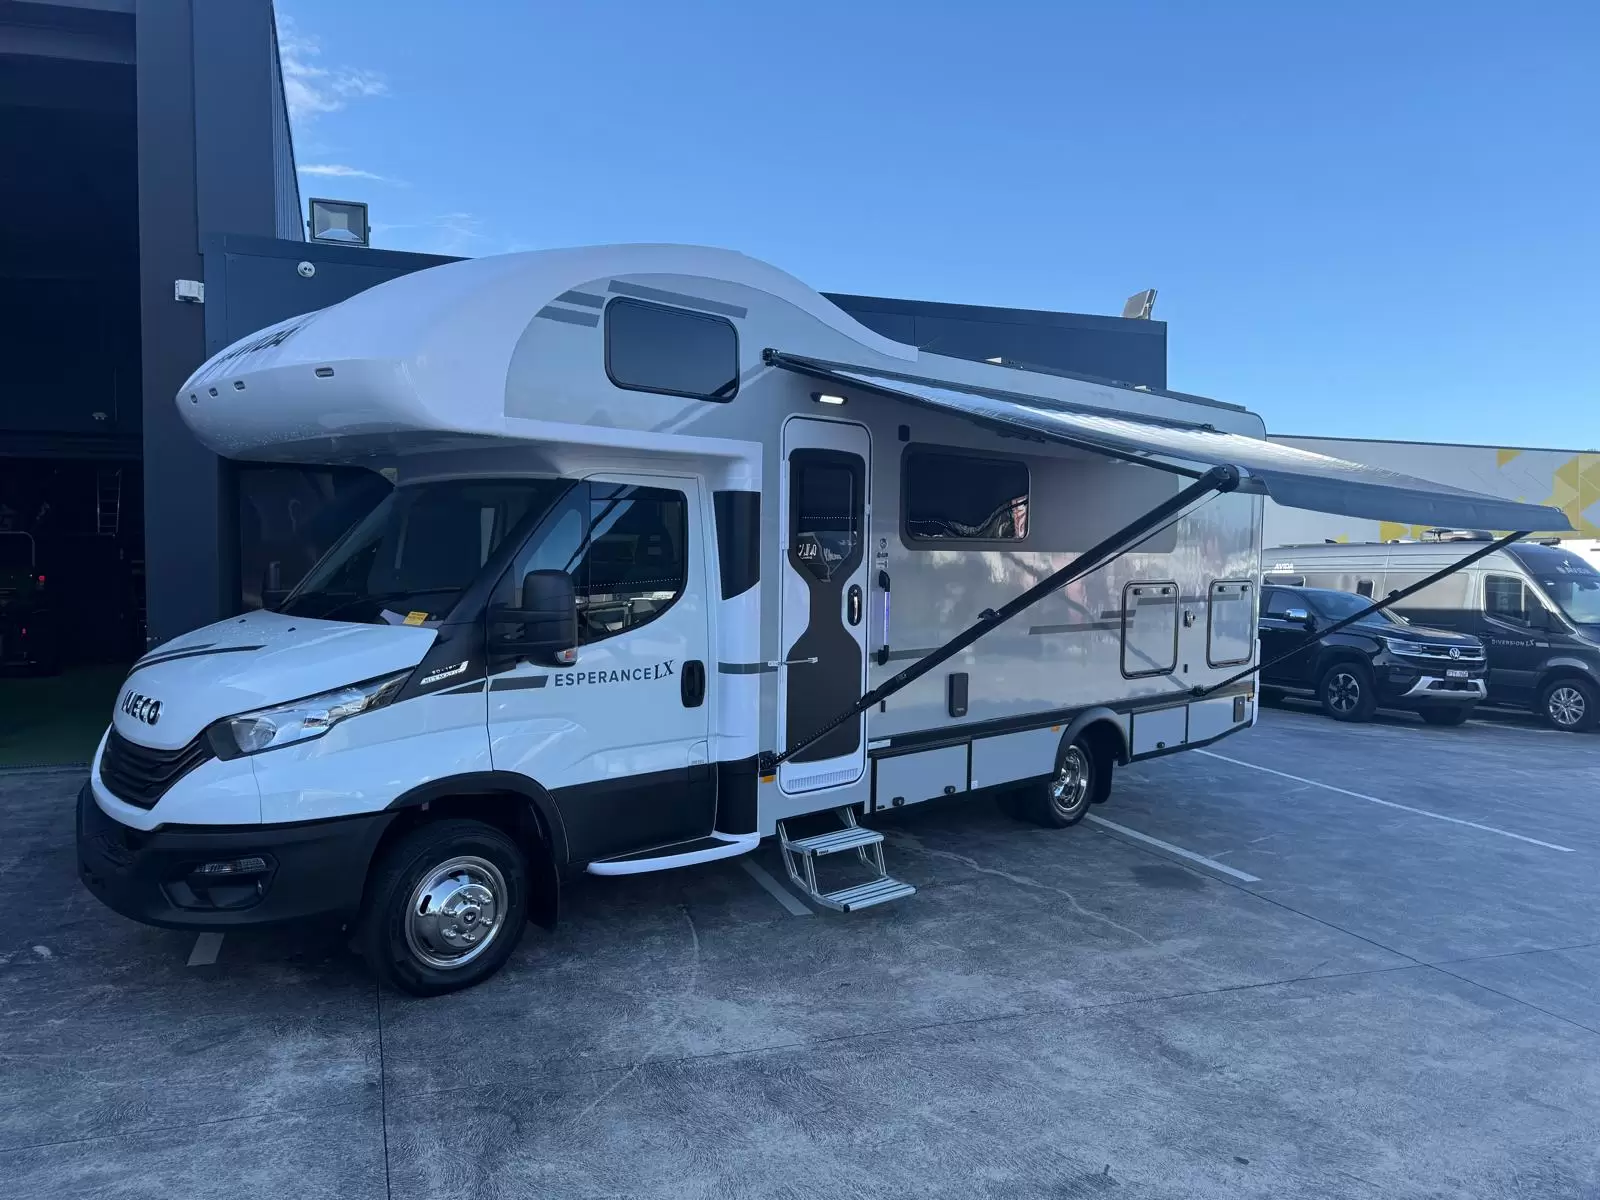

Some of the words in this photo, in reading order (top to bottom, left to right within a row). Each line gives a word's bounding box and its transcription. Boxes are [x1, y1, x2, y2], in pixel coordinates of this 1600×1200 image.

[554, 667, 652, 688] ESPERANCE
[653, 659, 675, 681] LX
[121, 689, 162, 726] IVECO
